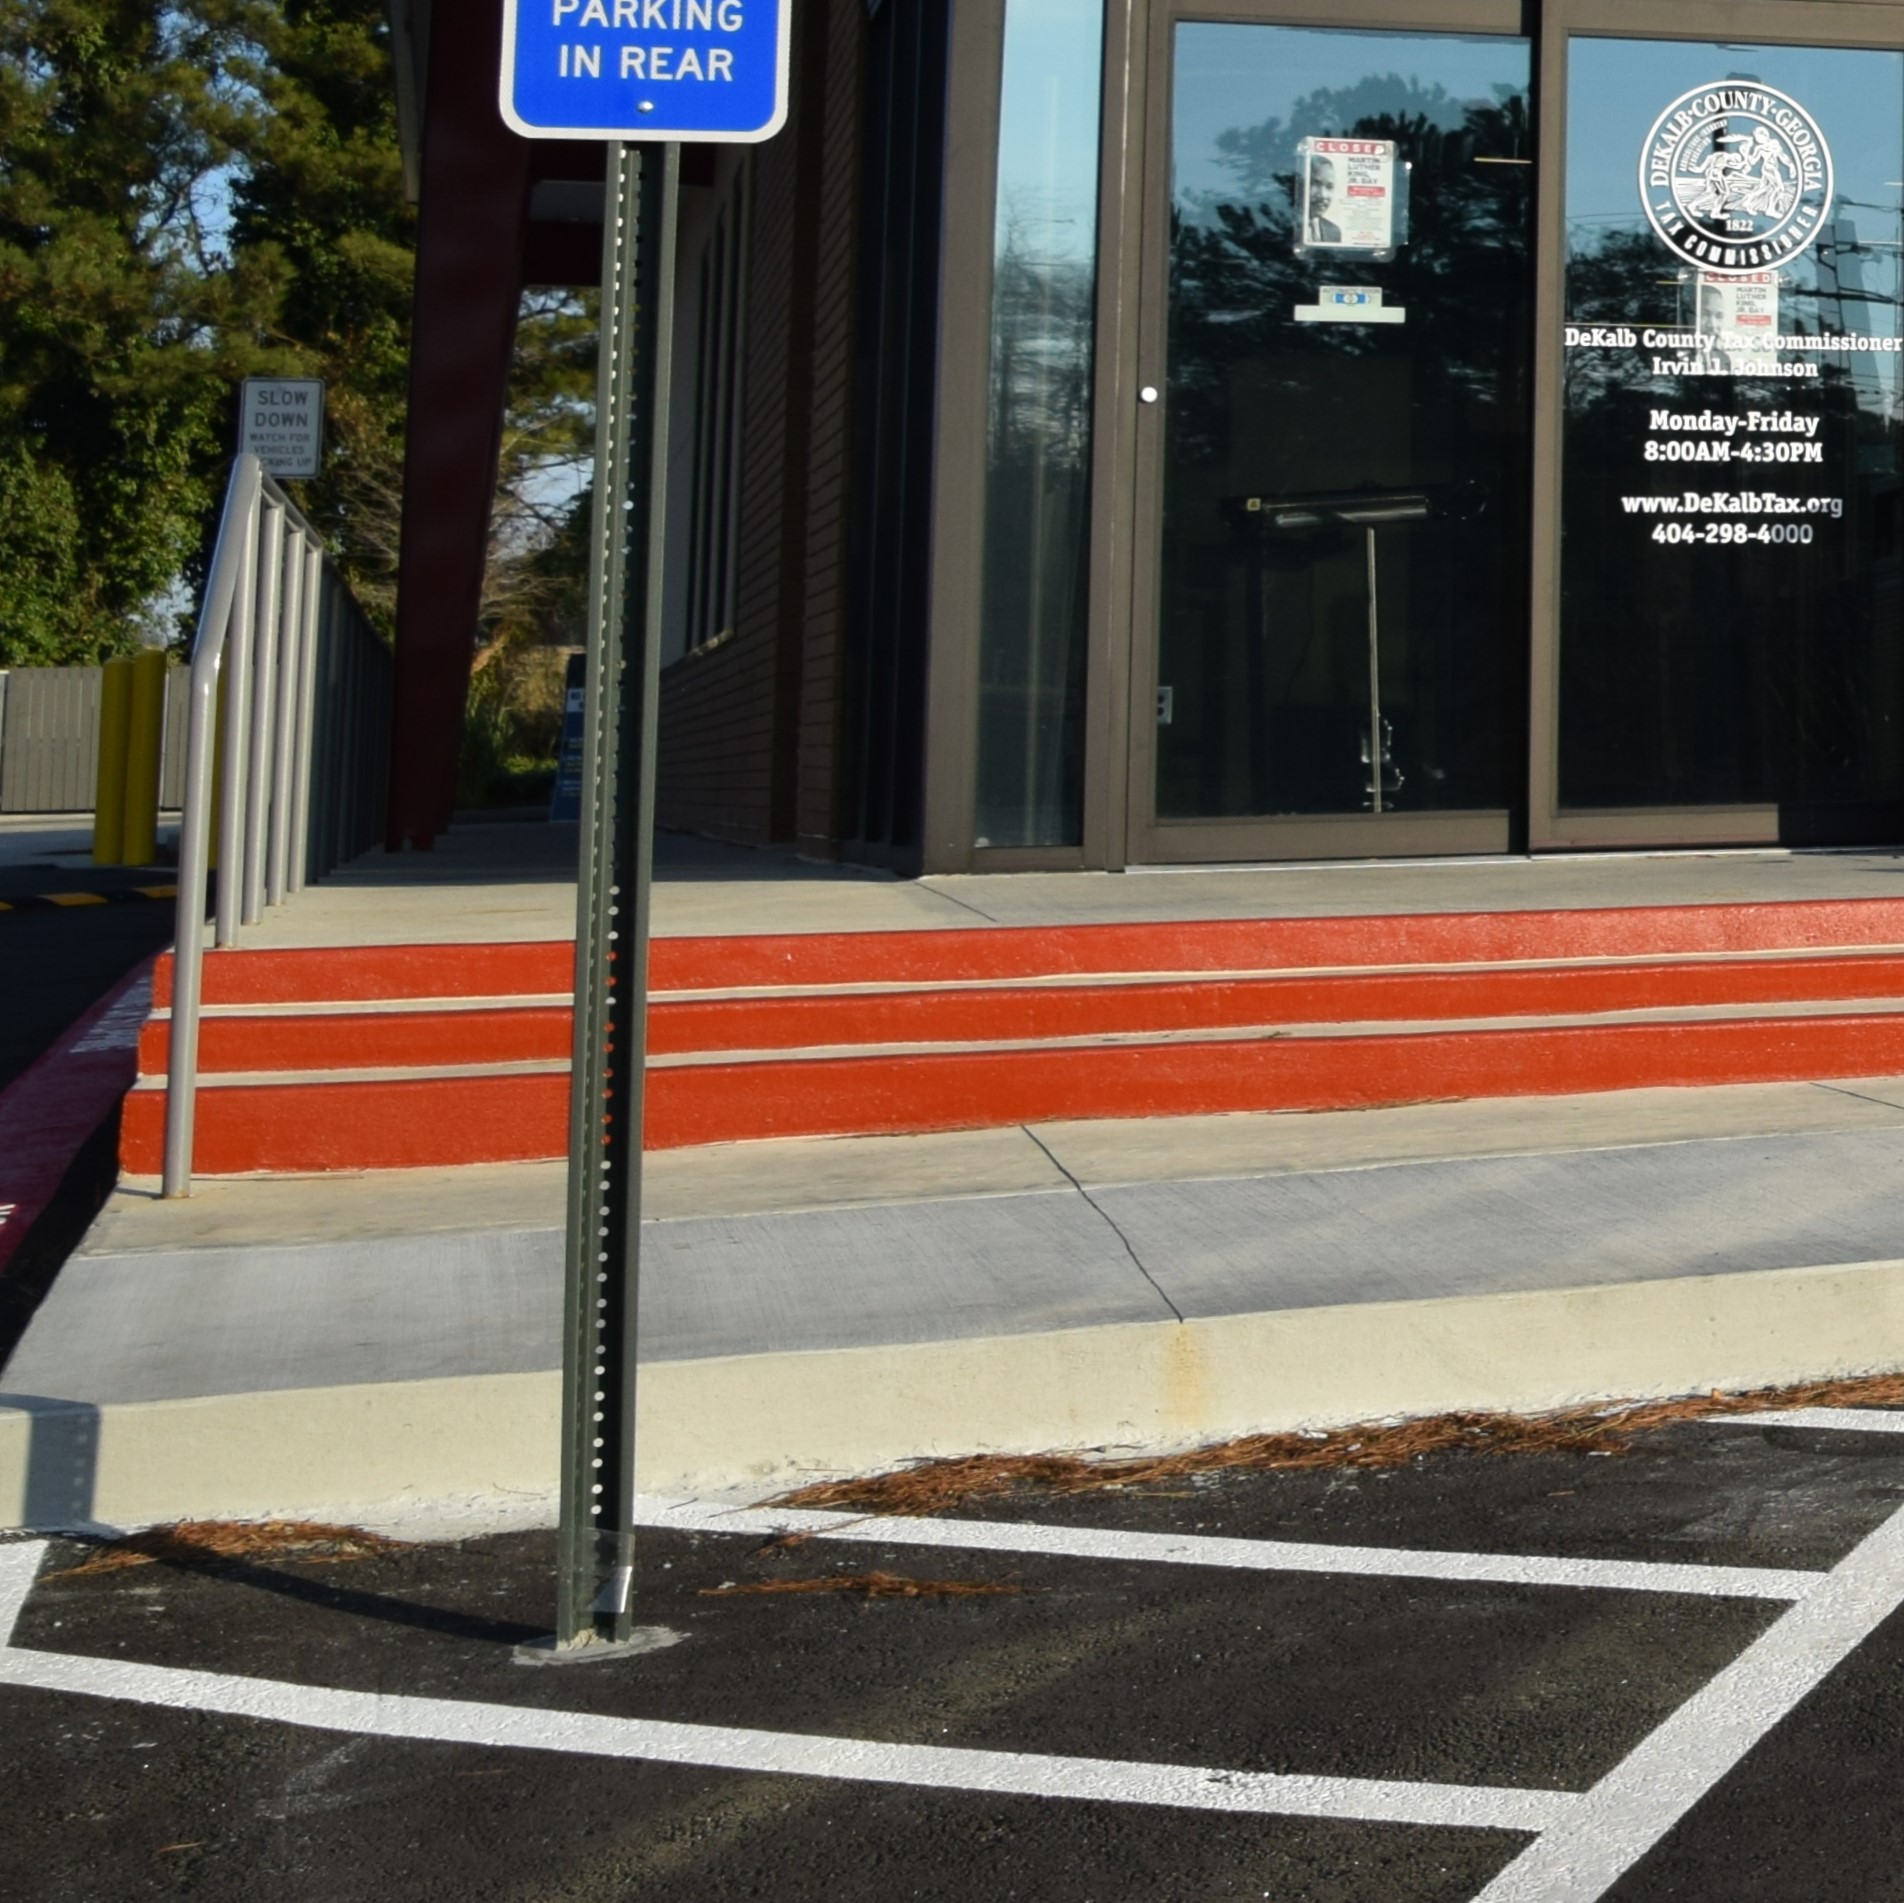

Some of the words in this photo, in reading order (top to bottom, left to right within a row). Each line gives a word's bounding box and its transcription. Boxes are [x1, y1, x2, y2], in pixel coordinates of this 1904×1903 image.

[559, 45, 602, 79] IN
[621, 47, 735, 83] REAR
[1775, 108, 1824, 192] GEORGIA
[1655, 200, 1684, 237] TAX
[1683, 205, 1820, 267] COMMISSIONER
[1725, 219, 1754, 232] 1822
[1564, 327, 1637, 348] DeKalb
[1642, 328, 1716, 353] County
[1721, 330, 1754, 351] Tax
[1761, 331, 1904, 353] Commissioner
[1651, 356, 1705, 377] Irvin
[1708, 358, 1729, 377] J.
[1734, 359, 1819, 378] Johnson
[257, 390, 309, 406] SLOW
[255, 412, 309, 427] DOWN
[1648, 409, 1820, 437] Monday-Friday
[254, 445, 305, 455] VEHICLES
[1643, 441, 1824, 463] 8:00AM-4:30PM
[1621, 492, 1844, 519] www.DeKalbTax.org
[1651, 523, 1814, 545] 404-298-4000
